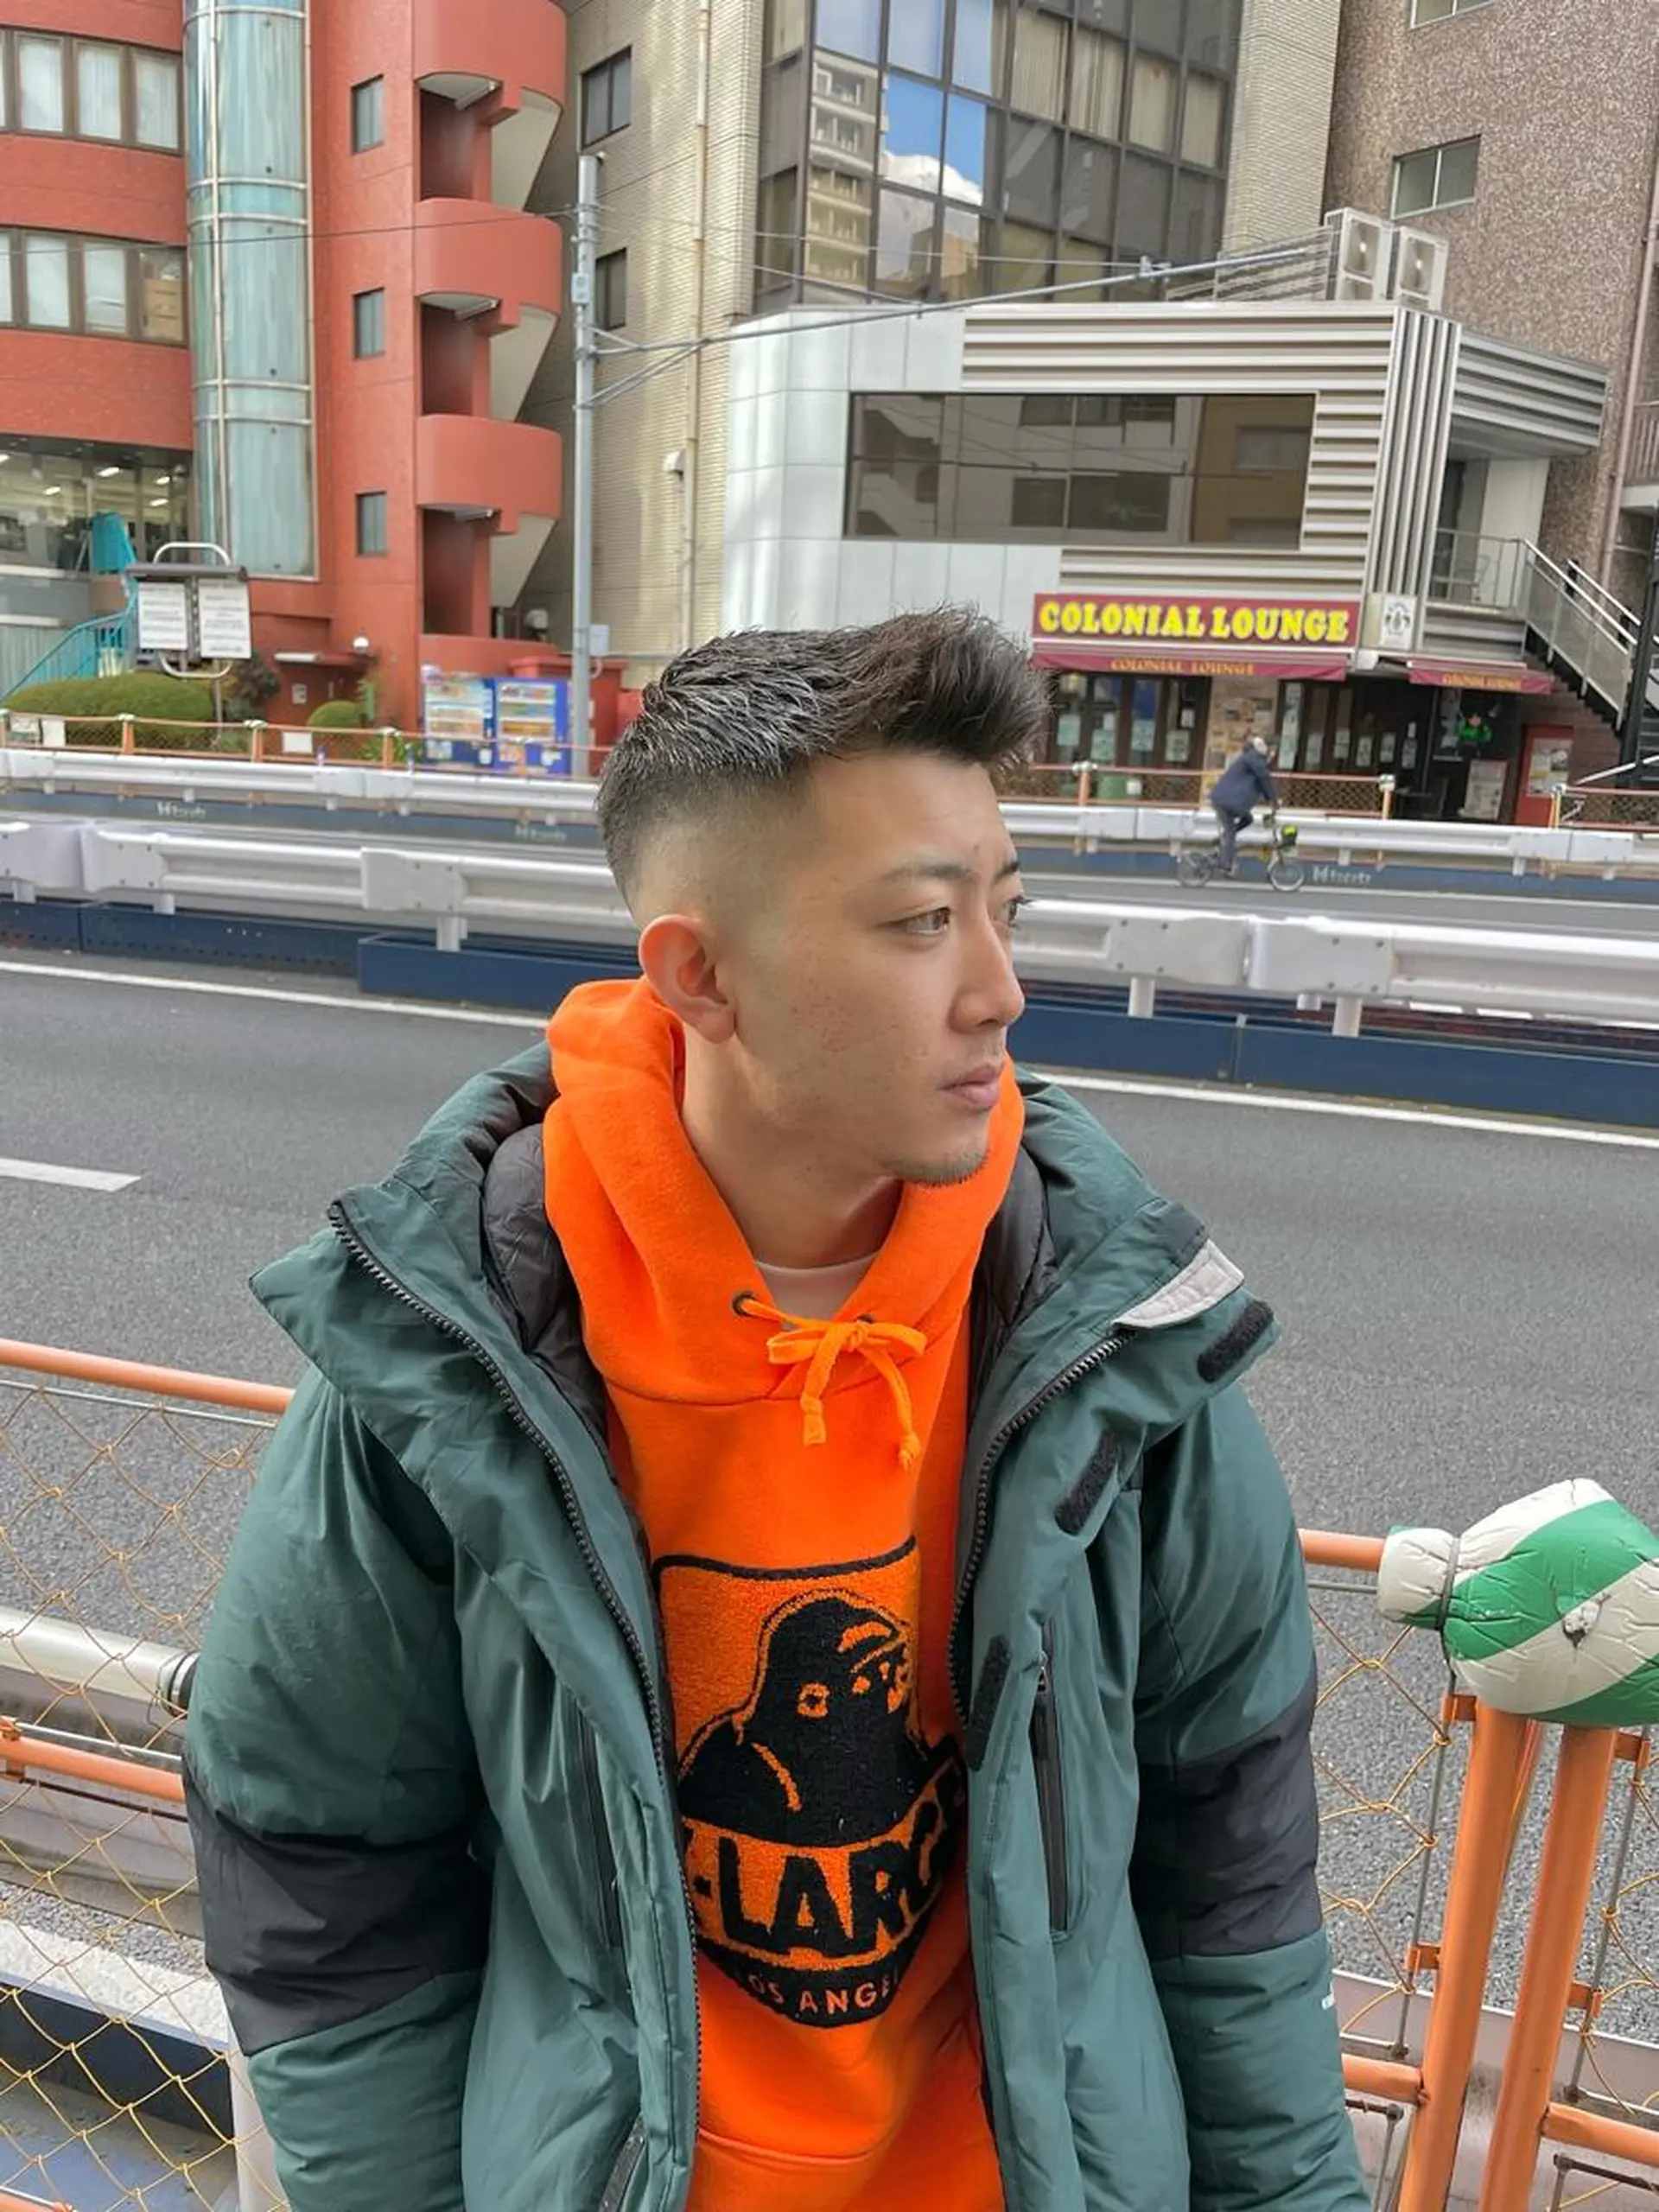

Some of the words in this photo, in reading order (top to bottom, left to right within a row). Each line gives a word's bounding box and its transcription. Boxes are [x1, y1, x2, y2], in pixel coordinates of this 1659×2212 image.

[1039, 601, 1206, 639] COLONIAL
[1210, 606, 1350, 643] LOUNGE
[744, 1973, 785, 2005] OS
